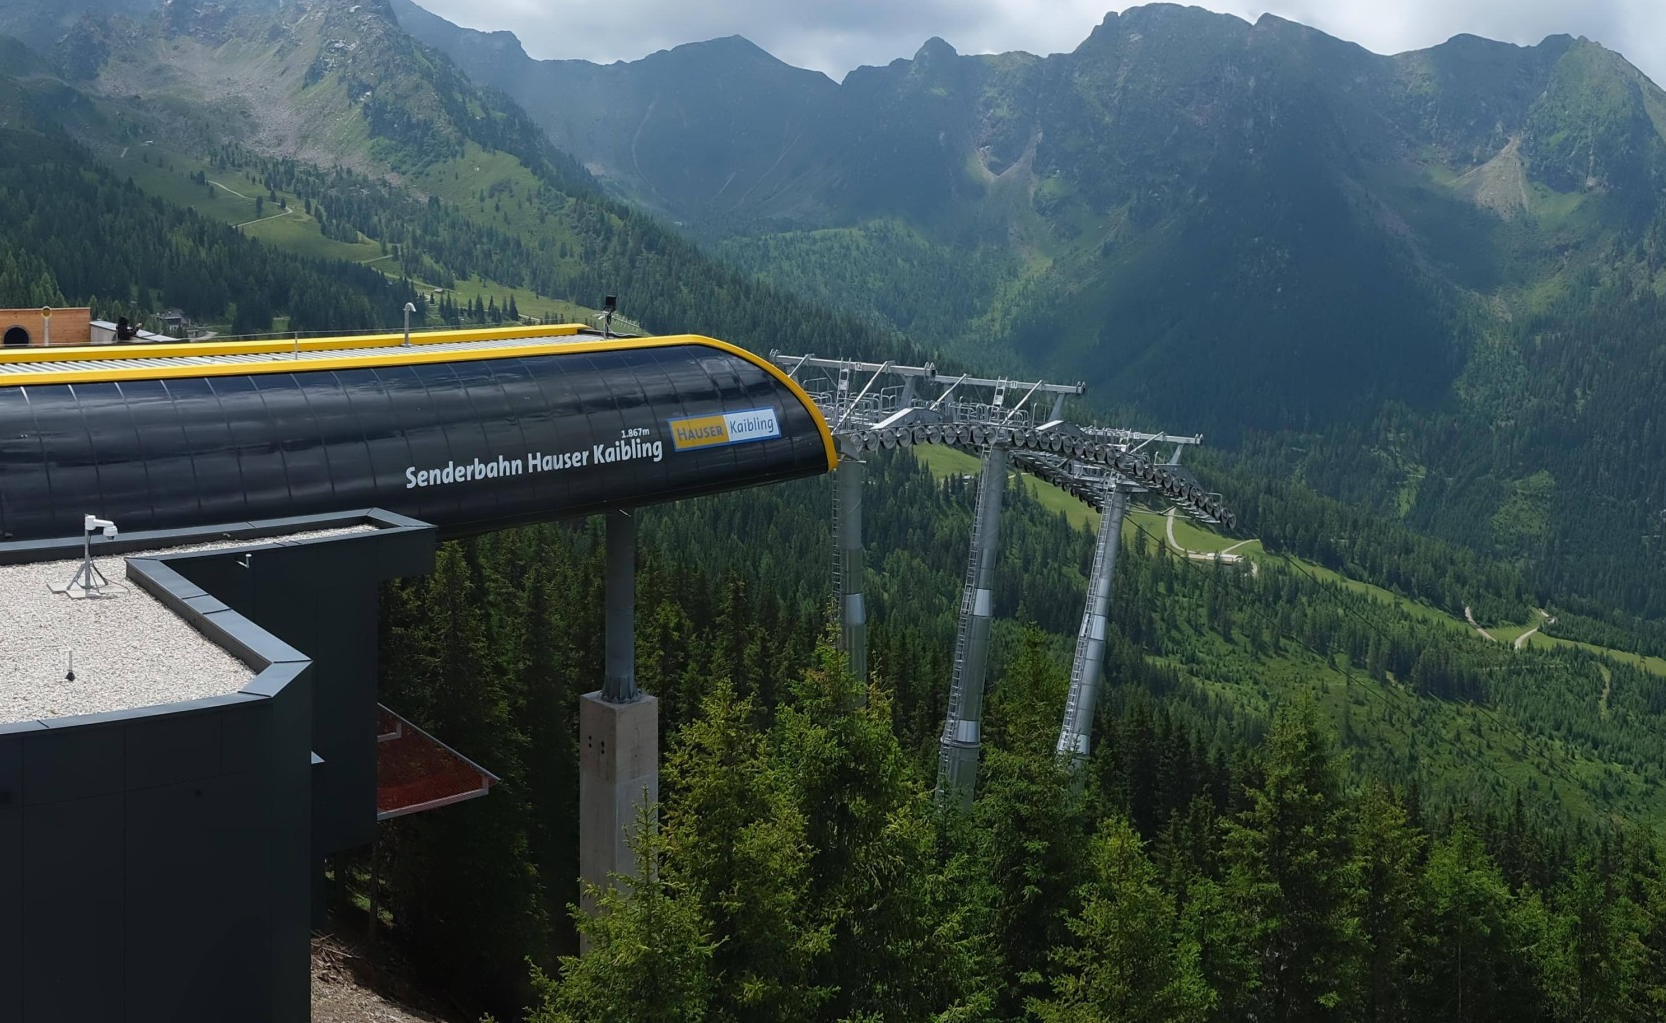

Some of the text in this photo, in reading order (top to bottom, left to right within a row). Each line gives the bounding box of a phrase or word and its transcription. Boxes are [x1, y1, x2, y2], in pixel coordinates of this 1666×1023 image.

[621, 428, 650, 439] 1.867m
[677, 416, 774, 442] HAUSER Kaibling
[406, 437, 663, 489] Senderbahn Hauser Kaibling
